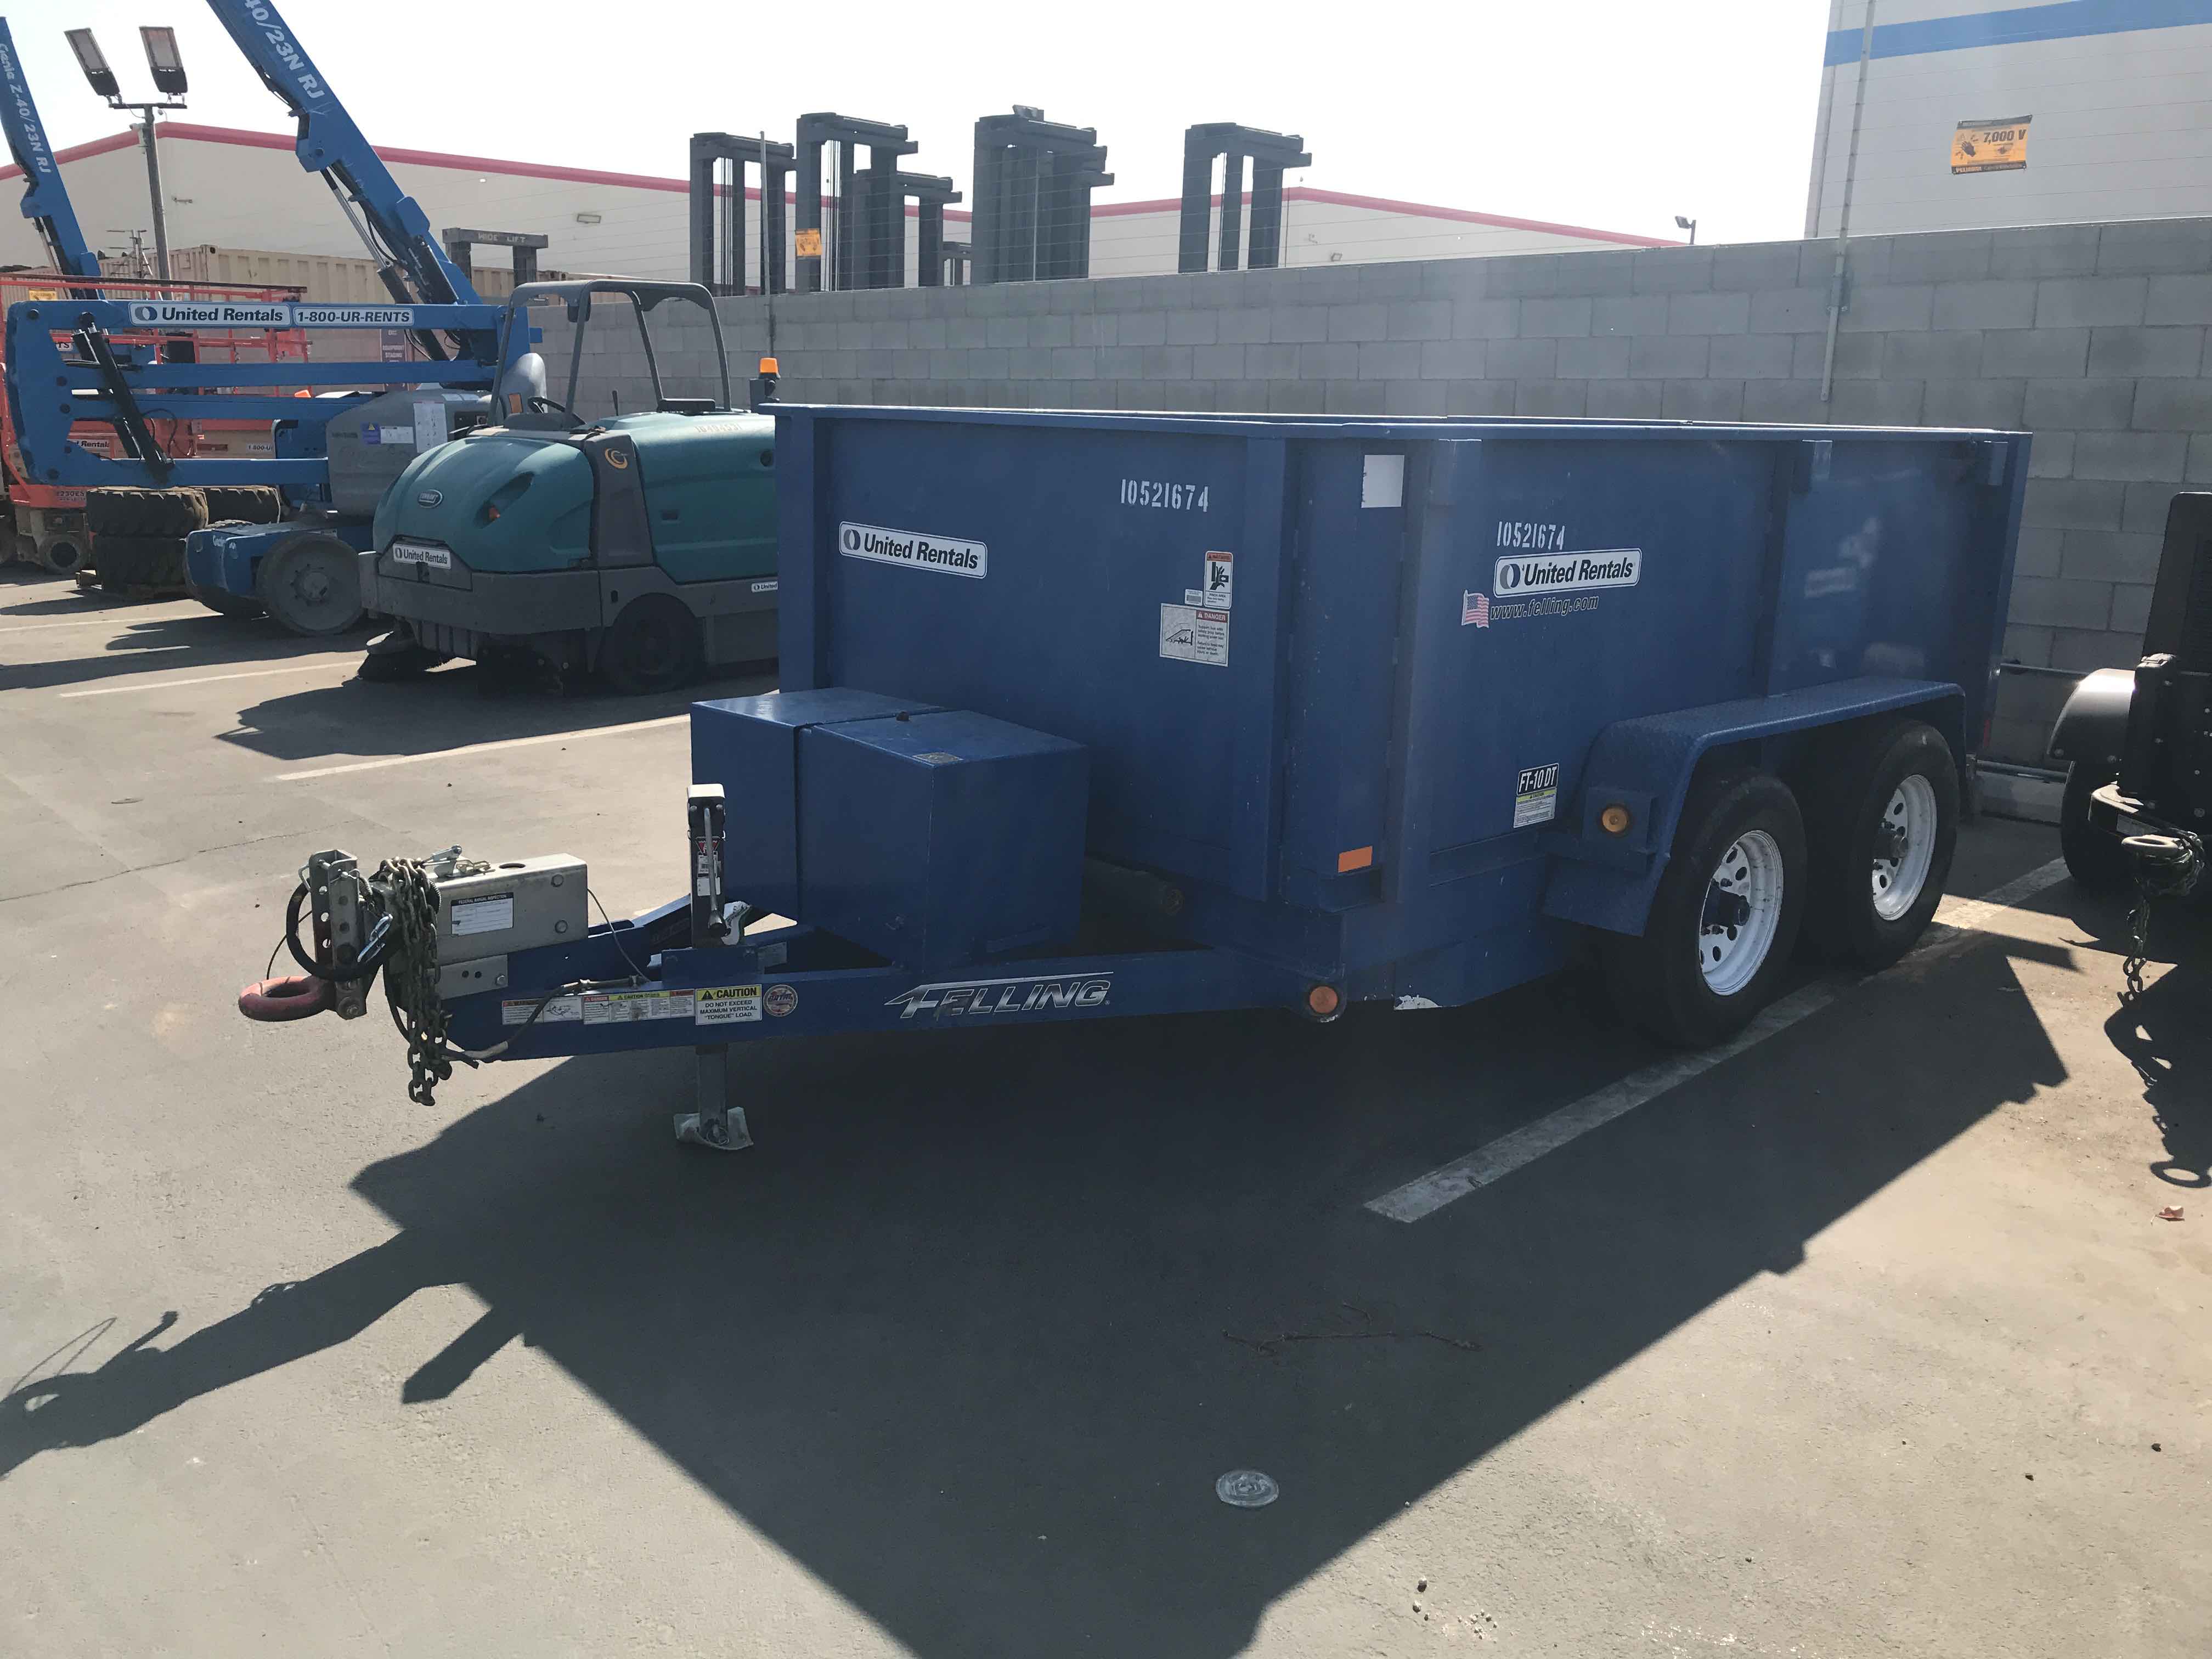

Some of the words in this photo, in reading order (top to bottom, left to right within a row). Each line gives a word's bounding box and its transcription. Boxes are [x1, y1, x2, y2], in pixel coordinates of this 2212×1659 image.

[297, 74, 325, 98] RJ
[9, 83, 44, 153] Z-40/23N
[36, 156, 52, 173] RJ
[1983, 130, 2015, 145] 7,000
[2018, 129, 2027, 140] V
[162, 308, 218, 321] United
[223, 308, 283, 322] Rentals
[297, 311, 410, 323] 1-800-UR-RENTS
[1121, 478, 1209, 512] 10521674
[1497, 521, 1565, 550] 10521674
[404, 549, 424, 561] United
[425, 551, 448, 565] Rentals
[864, 533, 913, 559] United
[916, 541, 979, 569] Rentals
[1523, 560, 1577, 586] United
[1578, 557, 1633, 581] Rentals
[1490, 596, 1599, 620] www.felling.com
[716, 988, 757, 998] CAUTION
[885, 975, 1111, 1019] FELLING
